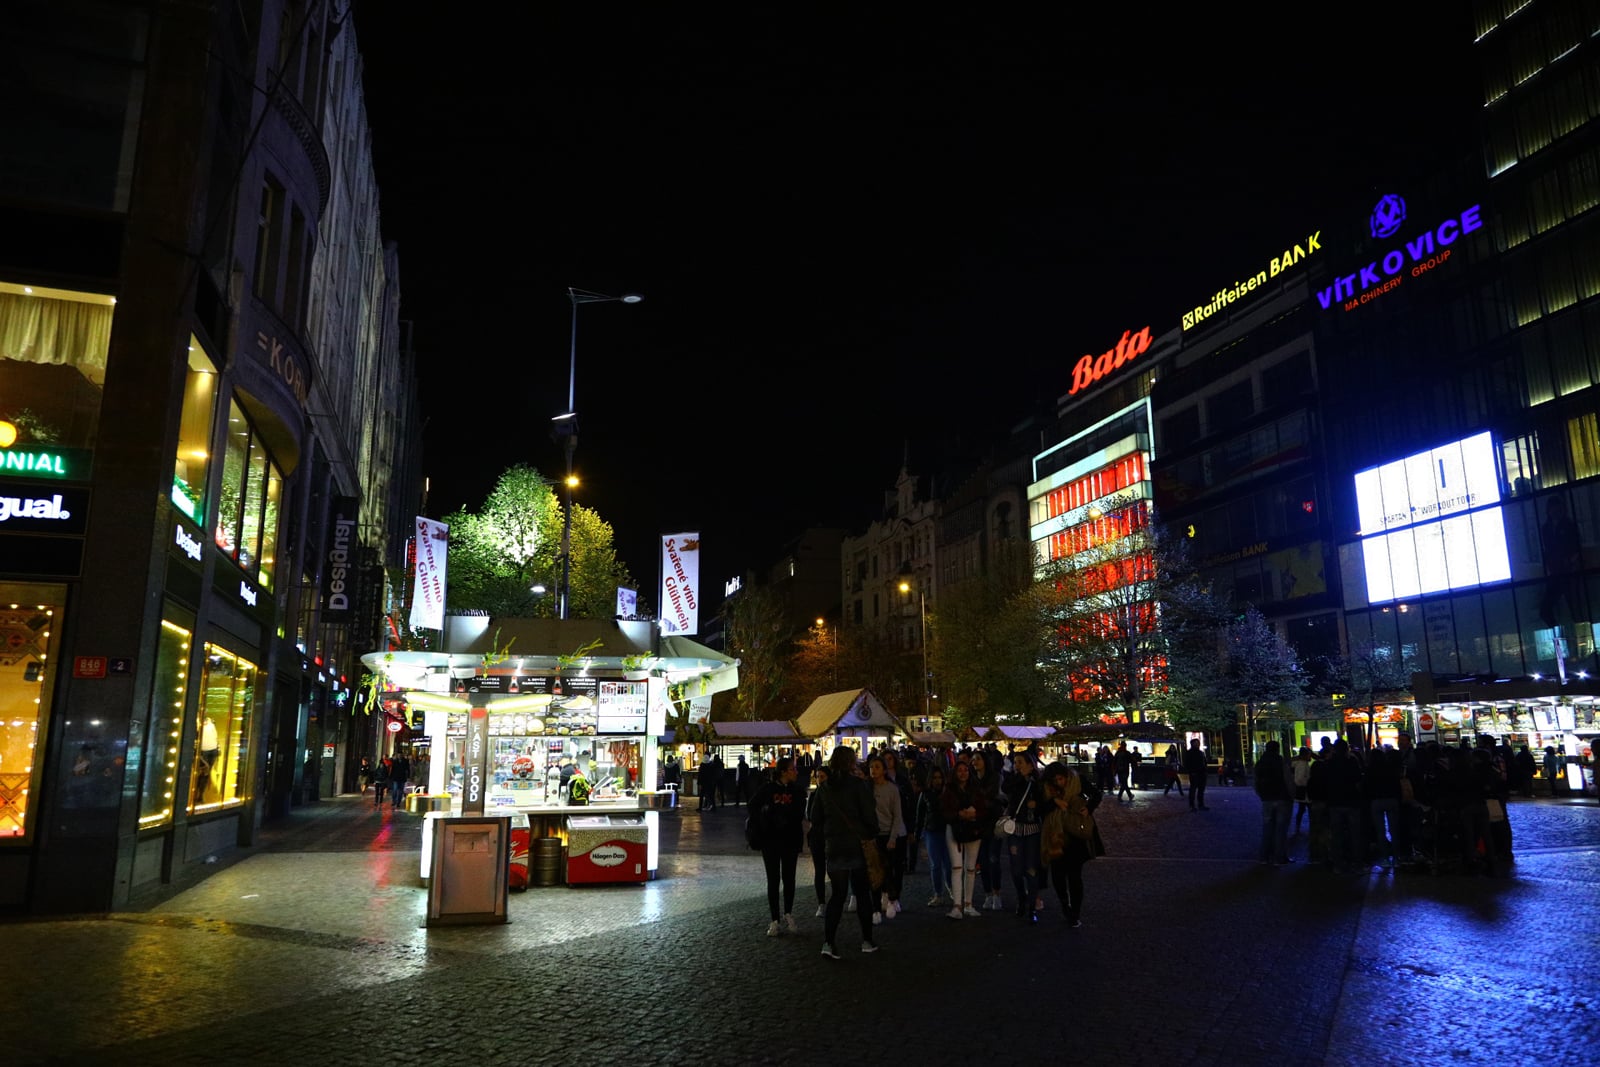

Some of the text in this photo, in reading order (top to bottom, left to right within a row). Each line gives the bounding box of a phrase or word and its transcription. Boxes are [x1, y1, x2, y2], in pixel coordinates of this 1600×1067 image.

[1194, 230, 1322, 324] Raiffeisen BANK
[1344, 249, 1451, 311] MACHINERY GROUP
[0, 452, 65, 473] NIAL
[1380, 513, 1407, 526] SARTAN
[1241, 542, 1269, 558] BANK
[432, 574, 442, 604] víno
[665, 538, 697, 611] Svařené víno
[665, 576, 689, 631] Glühwein
[472, 724, 481, 759] FAST
[469, 766, 480, 802] FOOD
